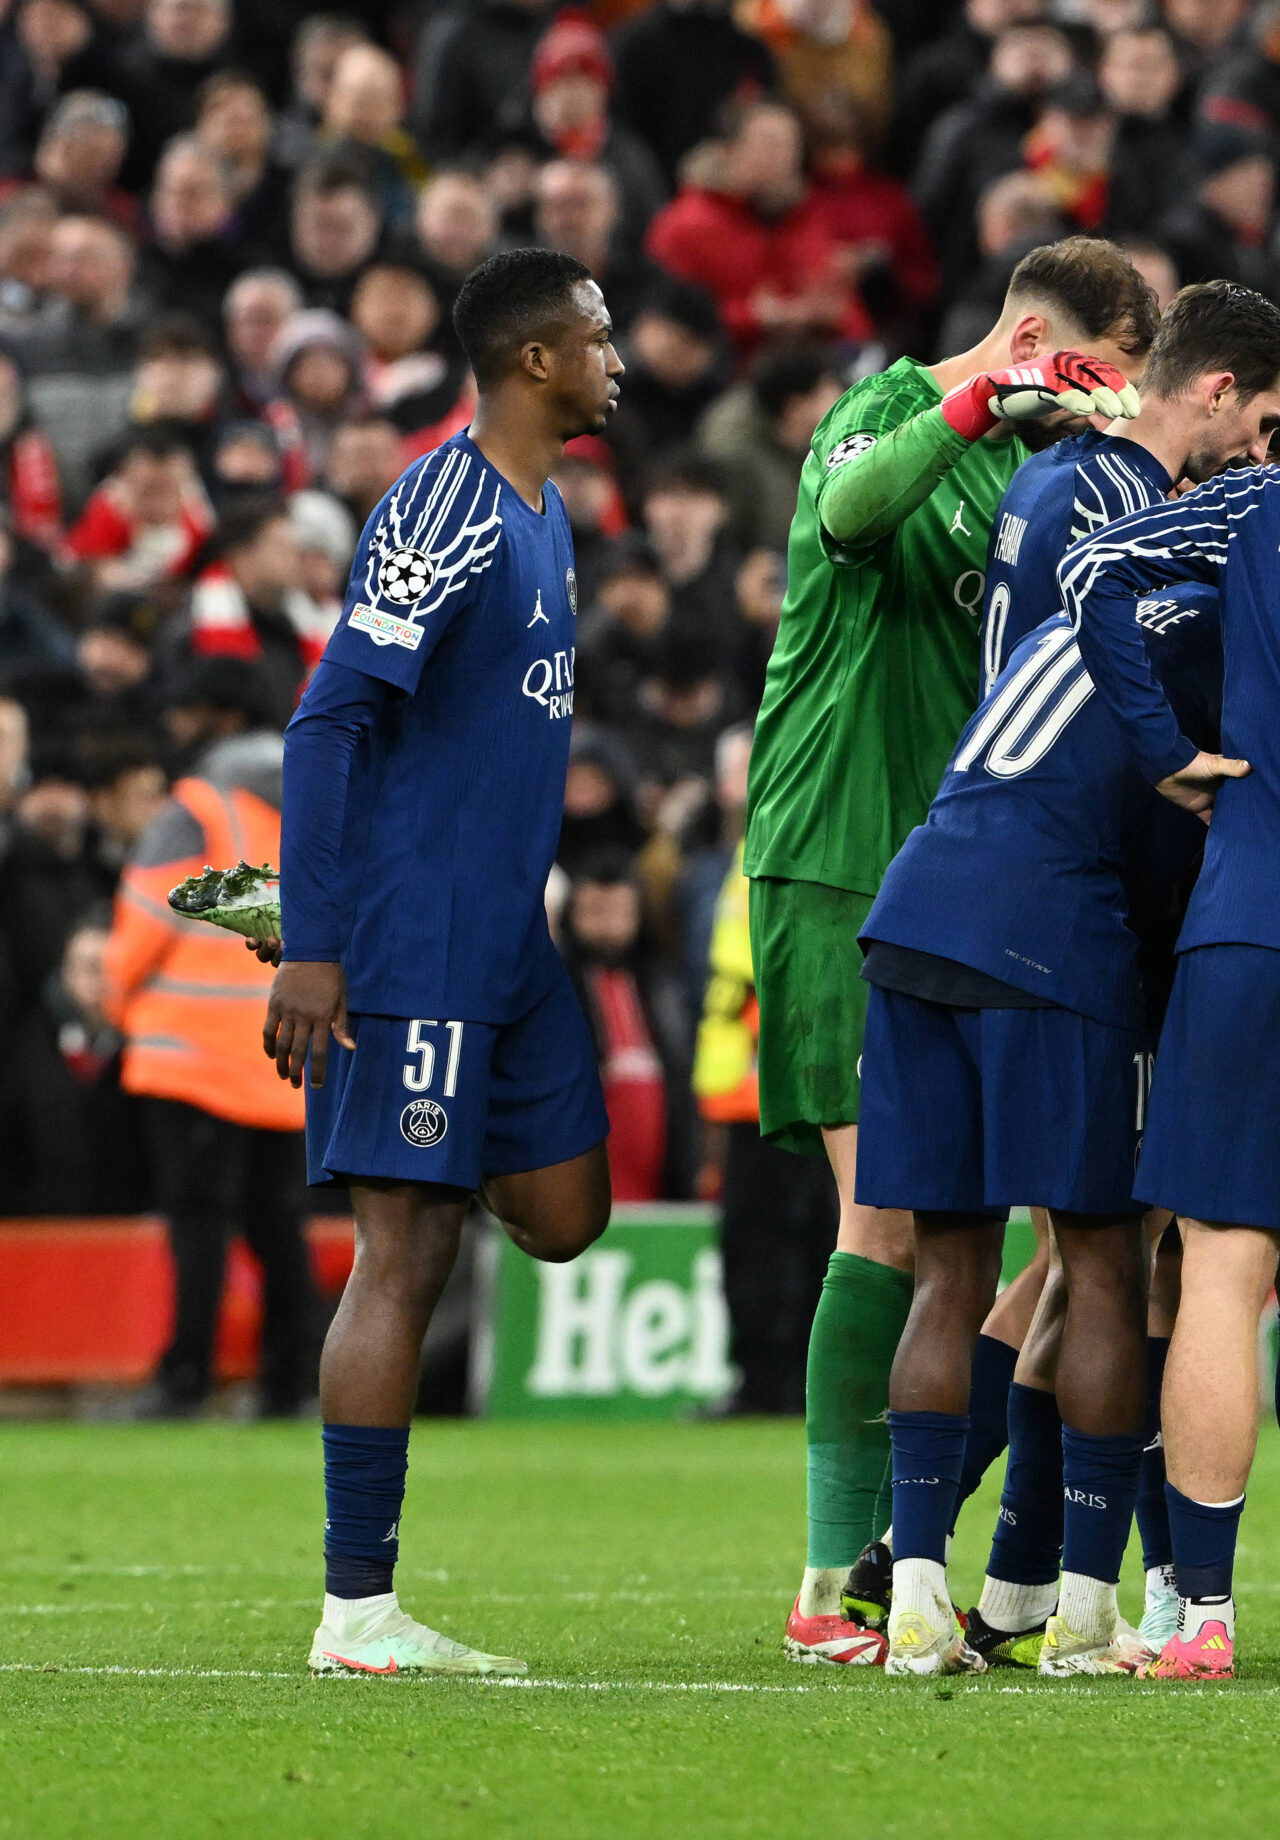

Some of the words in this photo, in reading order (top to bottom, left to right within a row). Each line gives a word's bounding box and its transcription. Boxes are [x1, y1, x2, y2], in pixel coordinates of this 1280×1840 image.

[353, 610, 420, 641] FOUNDATION
[953, 627, 1097, 779] 10
[403, 1019, 464, 1097] 51
[1133, 1052, 1155, 1130] 1
[409, 1102, 441, 1116] PARIS
